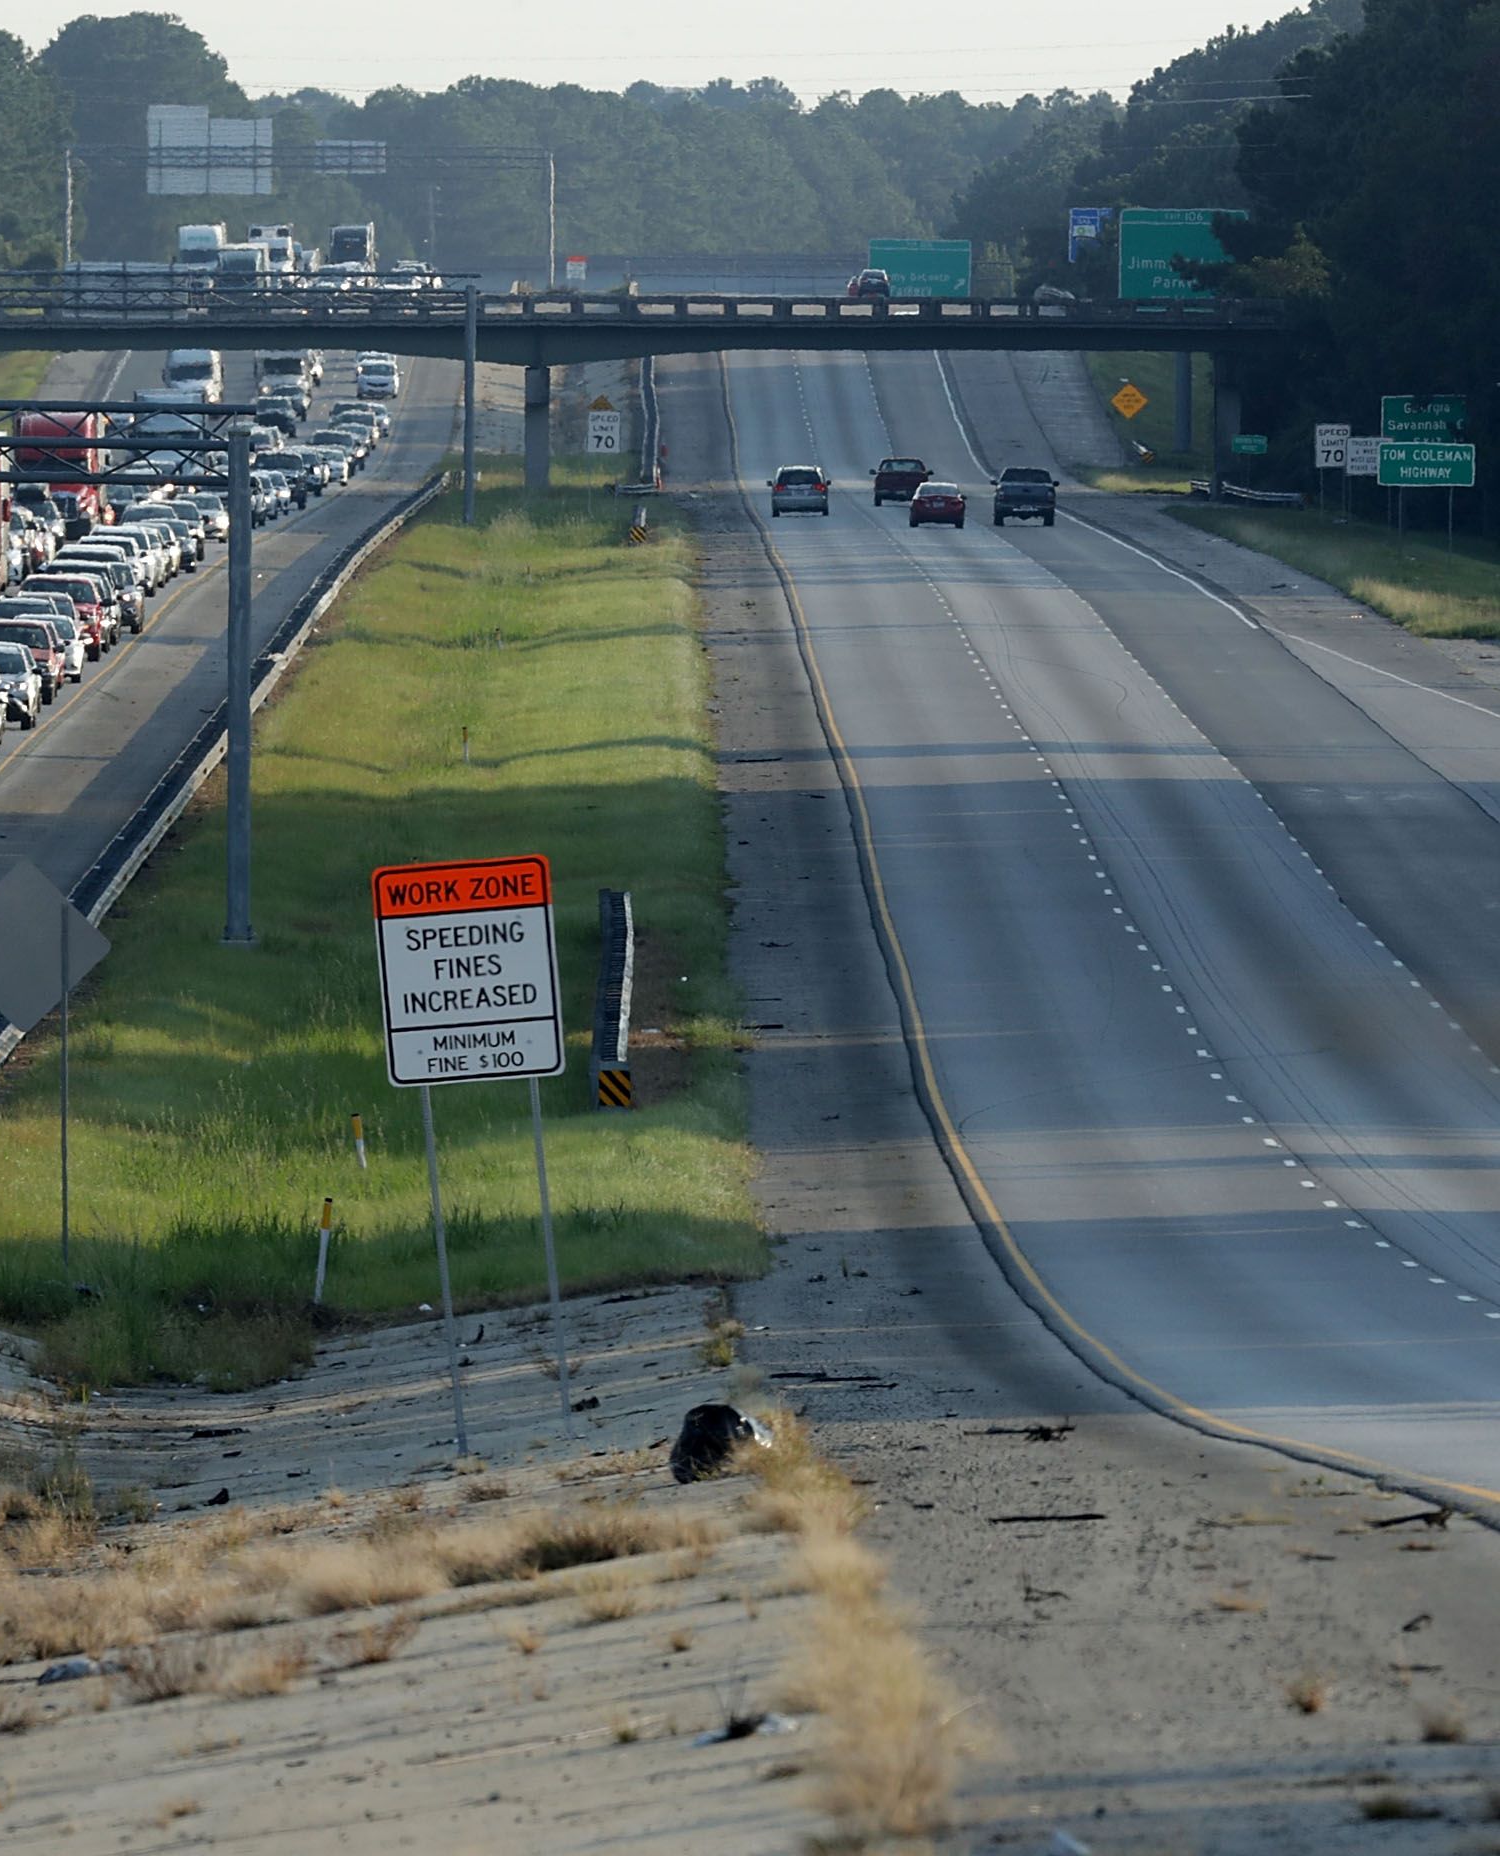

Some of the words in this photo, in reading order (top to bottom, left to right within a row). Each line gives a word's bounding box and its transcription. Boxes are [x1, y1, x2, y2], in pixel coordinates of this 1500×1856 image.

[1184, 211, 1204, 221] 106
[1127, 256, 1173, 272] Jimm
[1403, 402, 1451, 416] Grgia
[590, 414, 619, 422] SPEED
[1387, 418, 1447, 430] Savannah
[1318, 428, 1349, 437] SPEED
[593, 435, 615, 449] 70
[1321, 439, 1345, 447] LIMIT
[1321, 449, 1345, 463] 70
[1382, 449, 1406, 461] TOM
[1412, 449, 1471, 462] COLEMAN
[1399, 466, 1452, 479] HIGHWAY
[387, 879, 461, 907] WORK
[469, 873, 537, 900] ZONE
[406, 921, 525, 952] SPEEDING
[434, 954, 502, 980] FINES
[404, 983, 537, 1014] INCREASED
[433, 1030, 516, 1051] MINIMUM
[428, 1055, 469, 1073] FINE
[479, 1051, 525, 1069] $100
